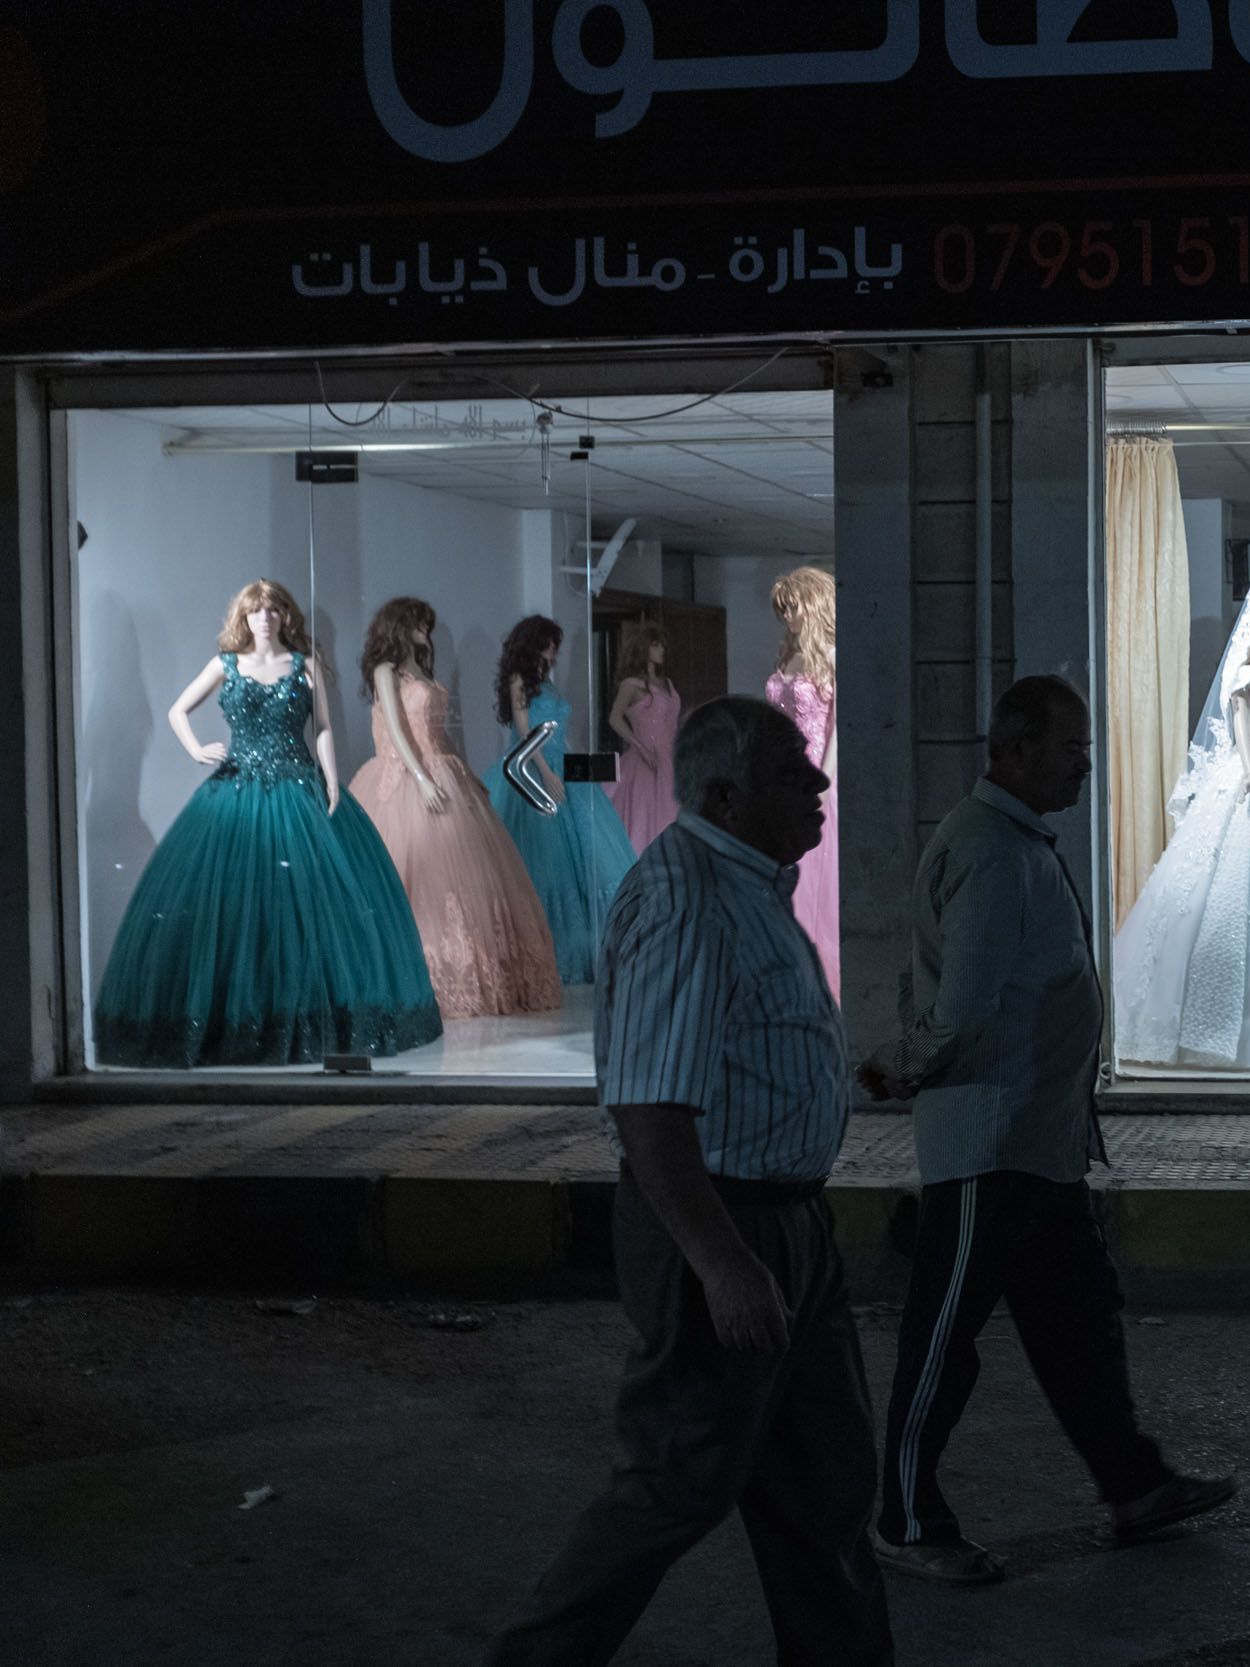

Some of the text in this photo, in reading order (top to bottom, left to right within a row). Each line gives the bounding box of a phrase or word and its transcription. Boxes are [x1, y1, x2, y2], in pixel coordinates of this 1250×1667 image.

[290, 241, 509, 306] ذيابات
[528, 237, 688, 307] منال
[728, 225, 905, 294] بإدارة
